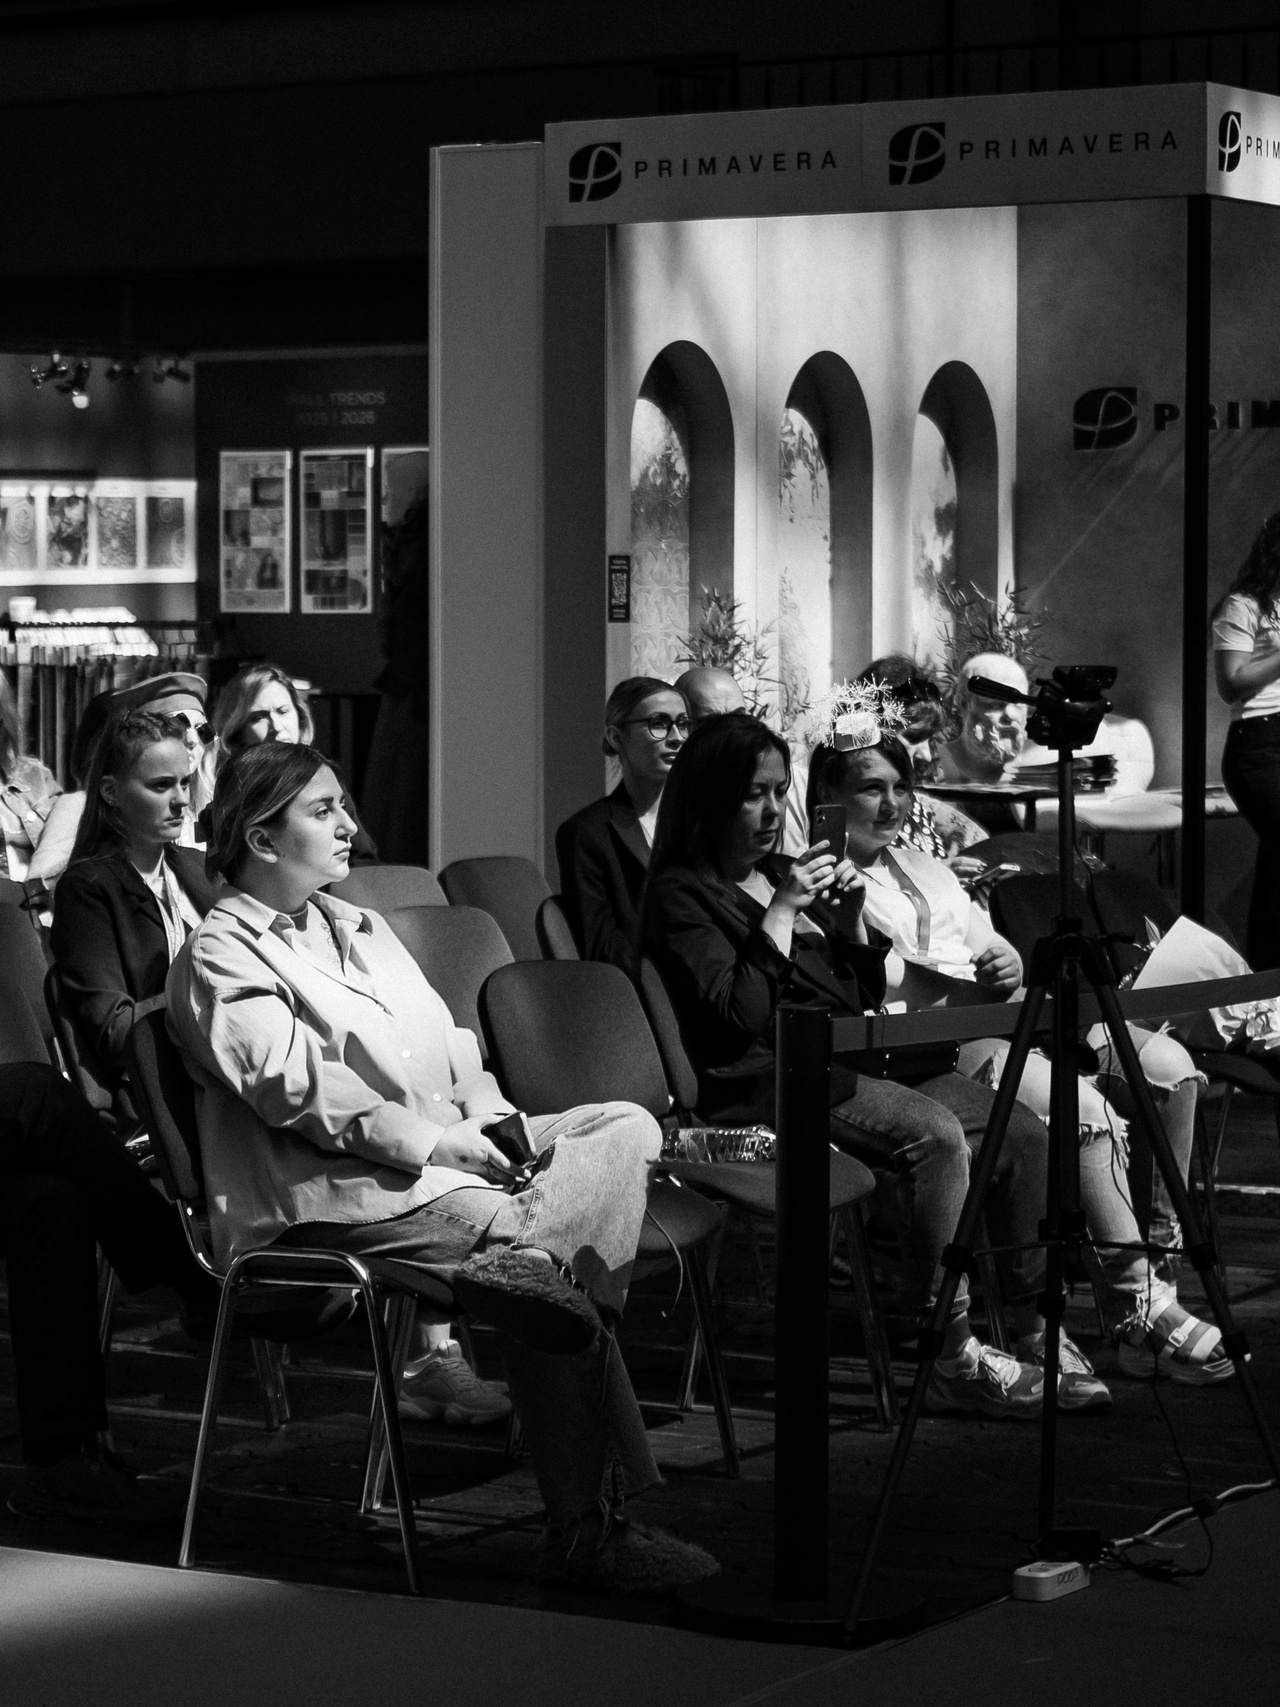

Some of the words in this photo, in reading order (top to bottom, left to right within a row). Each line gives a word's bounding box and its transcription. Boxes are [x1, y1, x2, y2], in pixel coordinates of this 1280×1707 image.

[959, 130, 1179, 161] PRIMAVERA
[634, 150, 838, 180] PRIMAVERA
[330, 391, 386, 406] TRENDS
[340, 411, 376, 425] 2026
